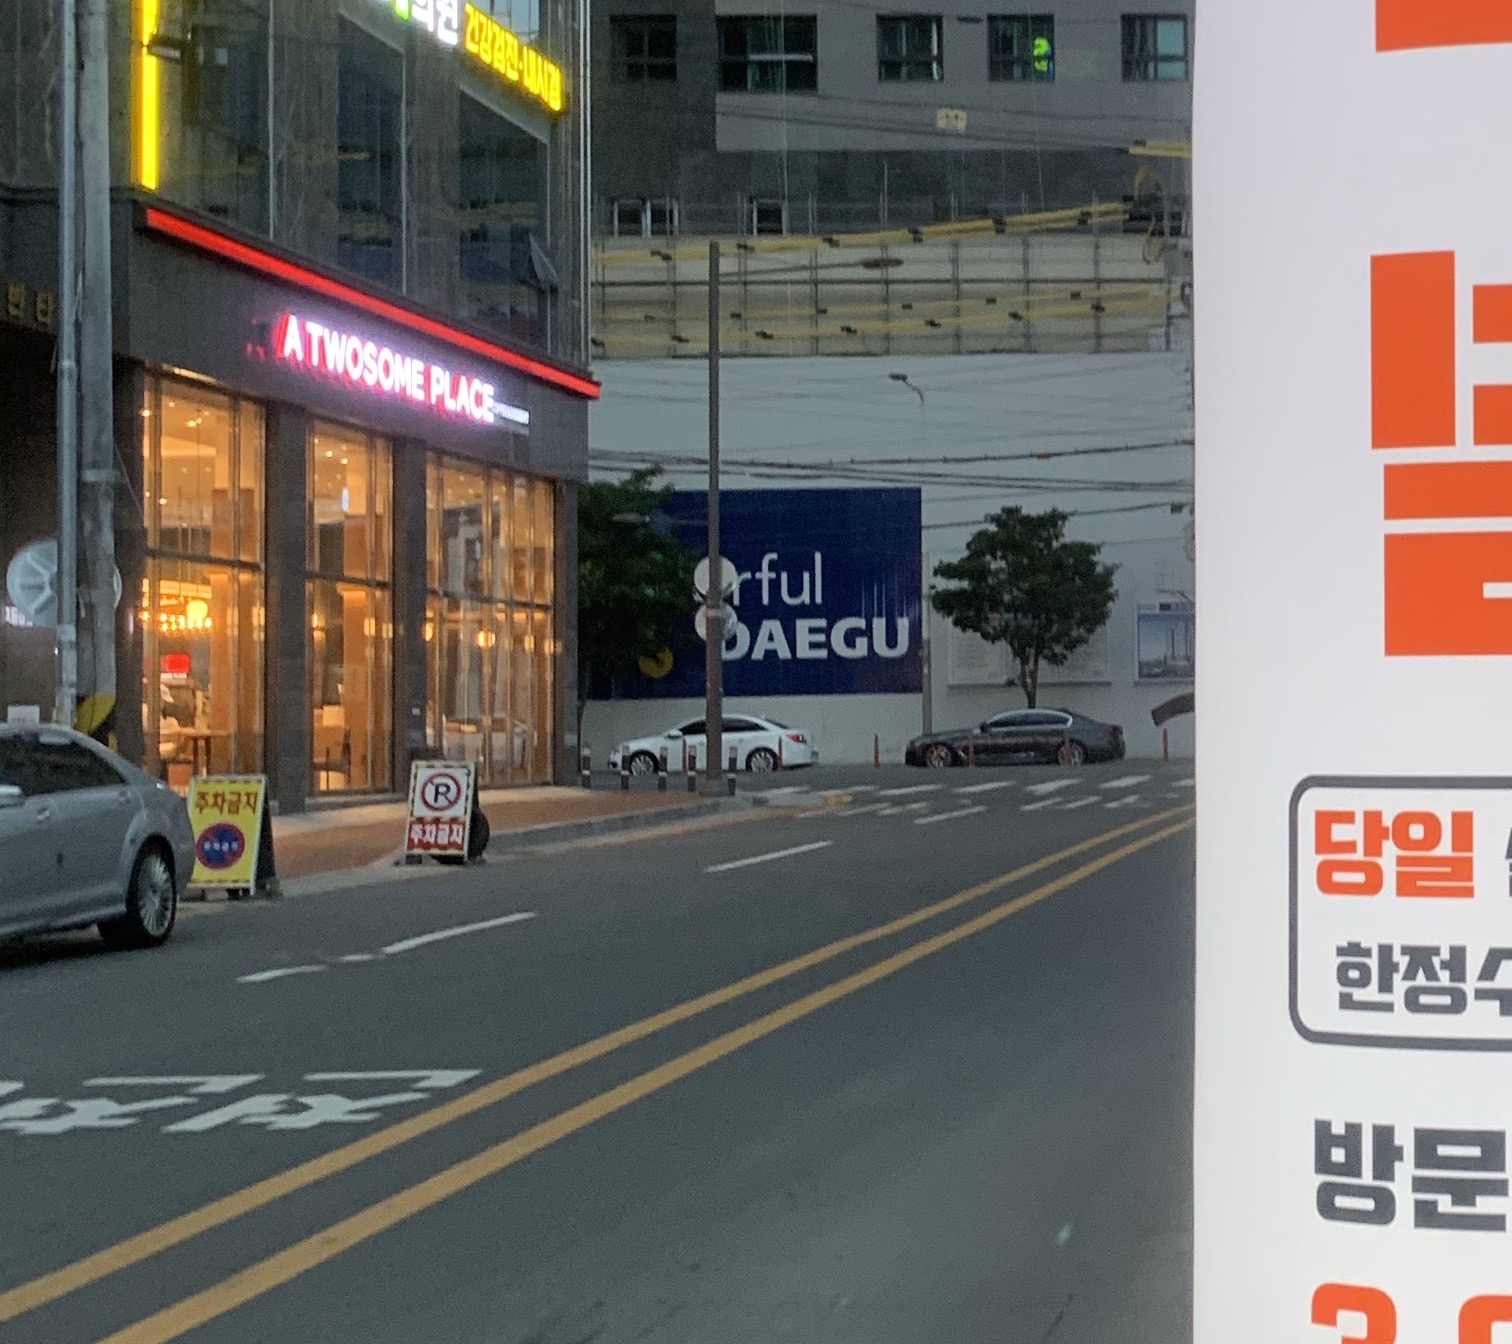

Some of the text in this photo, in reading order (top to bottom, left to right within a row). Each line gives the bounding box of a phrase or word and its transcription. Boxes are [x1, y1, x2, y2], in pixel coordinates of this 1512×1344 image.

[282, 314, 303, 362] A
[305, 319, 426, 402] TWOSOME
[430, 365, 495, 424] PLACE
[732, 551, 823, 606] rful
[721, 616, 910, 661] DAEGU
[195, 790, 259, 815] 주차금지
[410, 822, 464, 846] 주차금지
[1314, 809, 1475, 899] 당일
[1314, 1118, 1510, 1233] 방문
